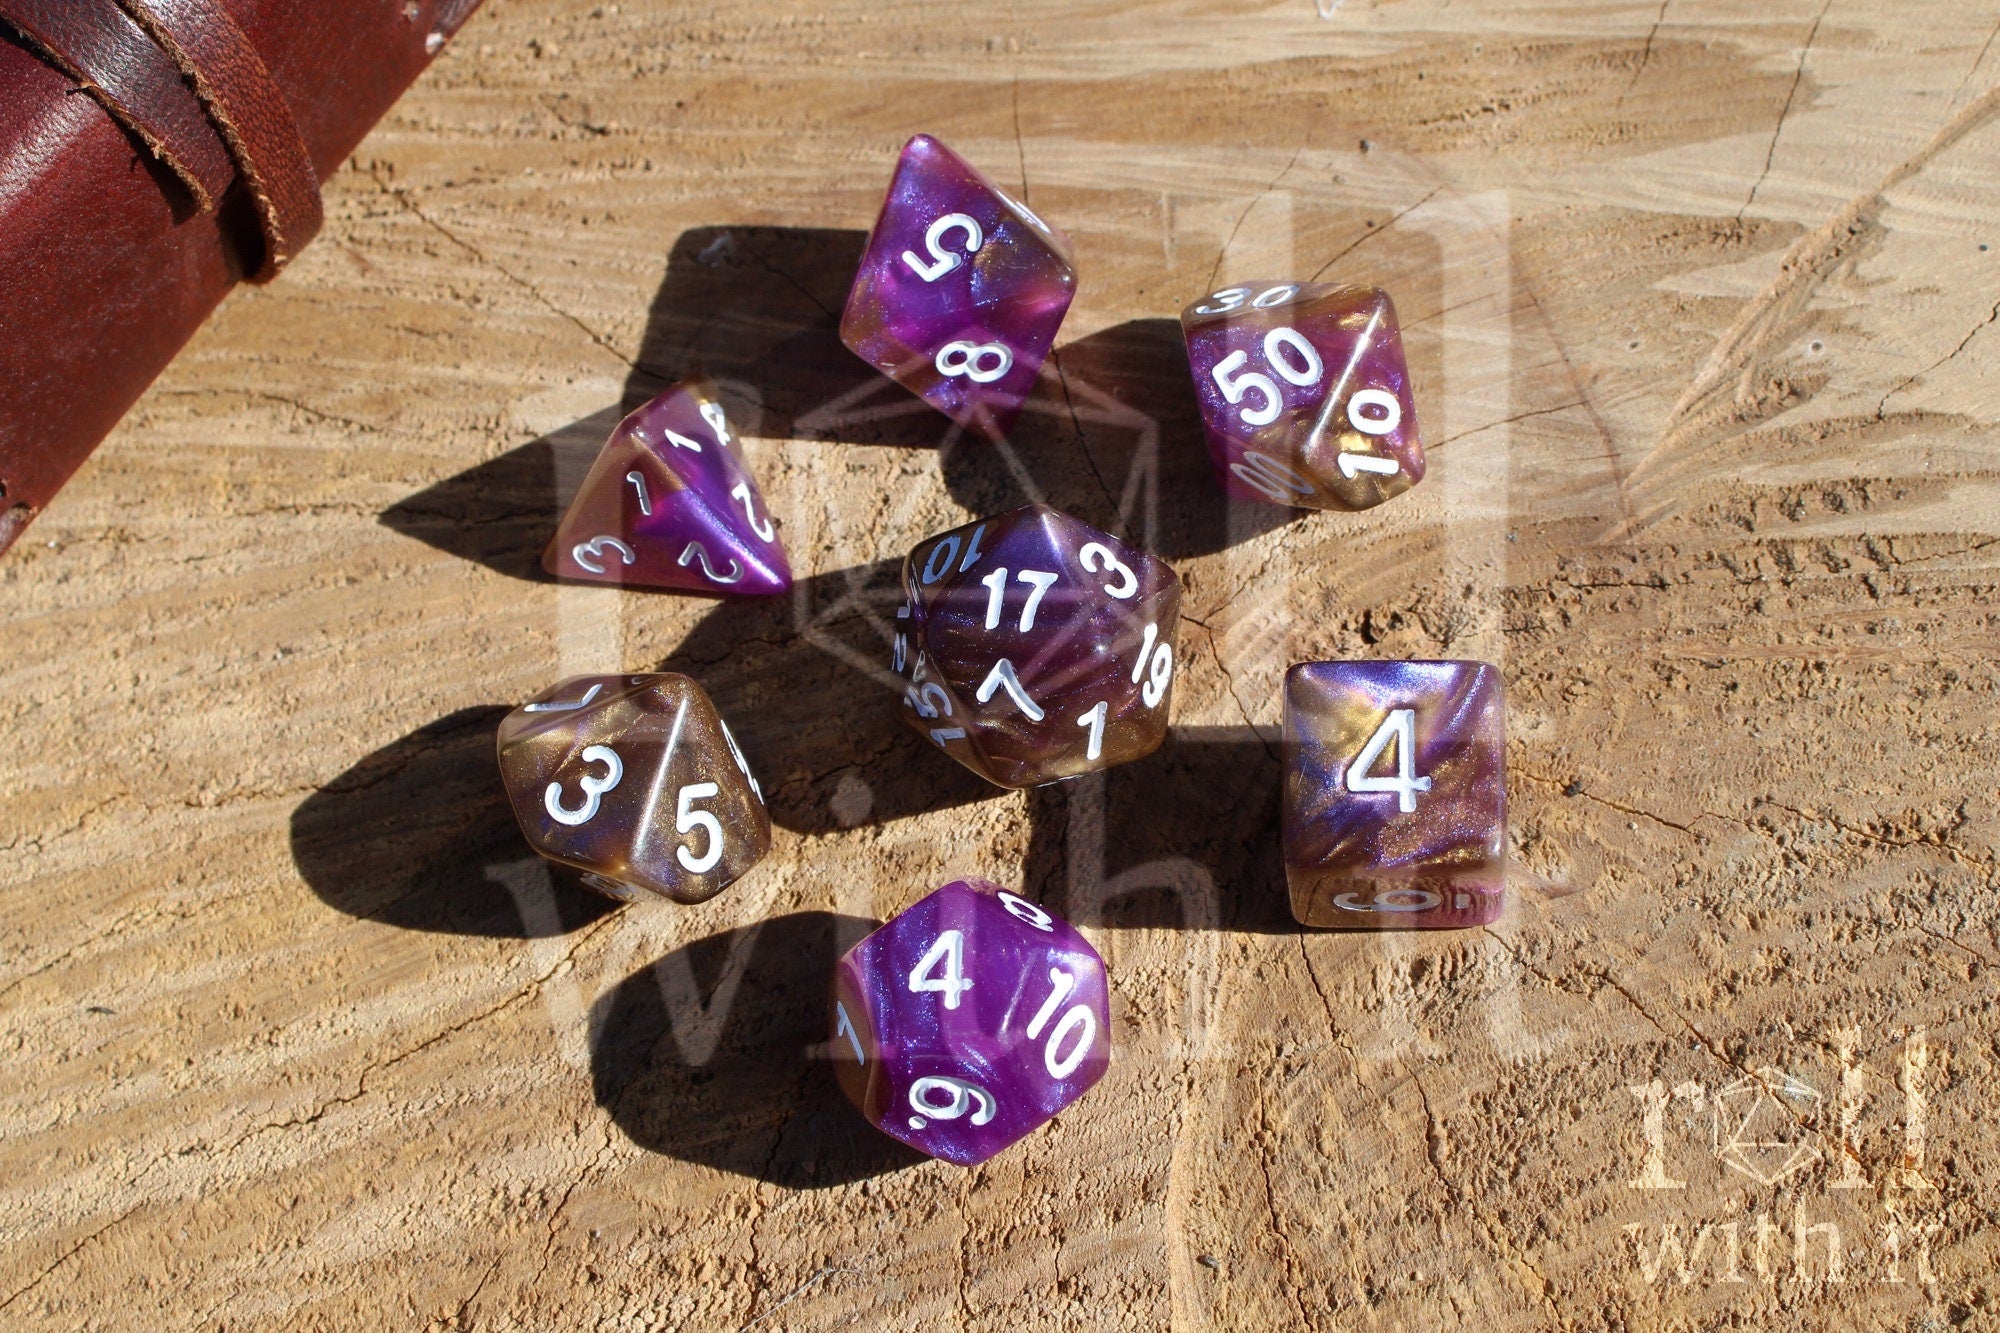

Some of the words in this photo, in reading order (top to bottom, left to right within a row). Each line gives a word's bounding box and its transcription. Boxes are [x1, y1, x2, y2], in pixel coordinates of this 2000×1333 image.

[902, 213, 983, 282] 5
[1195, 285, 1299, 315] 30
[935, 341, 1013, 383] 8
[1211, 327, 1323, 425] 50
[1338, 389, 1400, 478] 10
[573, 535, 635, 573] 3
[921, 524, 986, 585] 10
[1079, 542, 1138, 599] 3
[982, 567, 1059, 633] 17
[1131, 622, 1172, 709] 19
[1077, 701, 1108, 760] 1
[1347, 708, 1432, 813] 4
[544, 745, 623, 826] 3
[676, 782, 724, 873] 5
[908, 929, 973, 1010] 4
[1026, 967, 1097, 1080] 10
